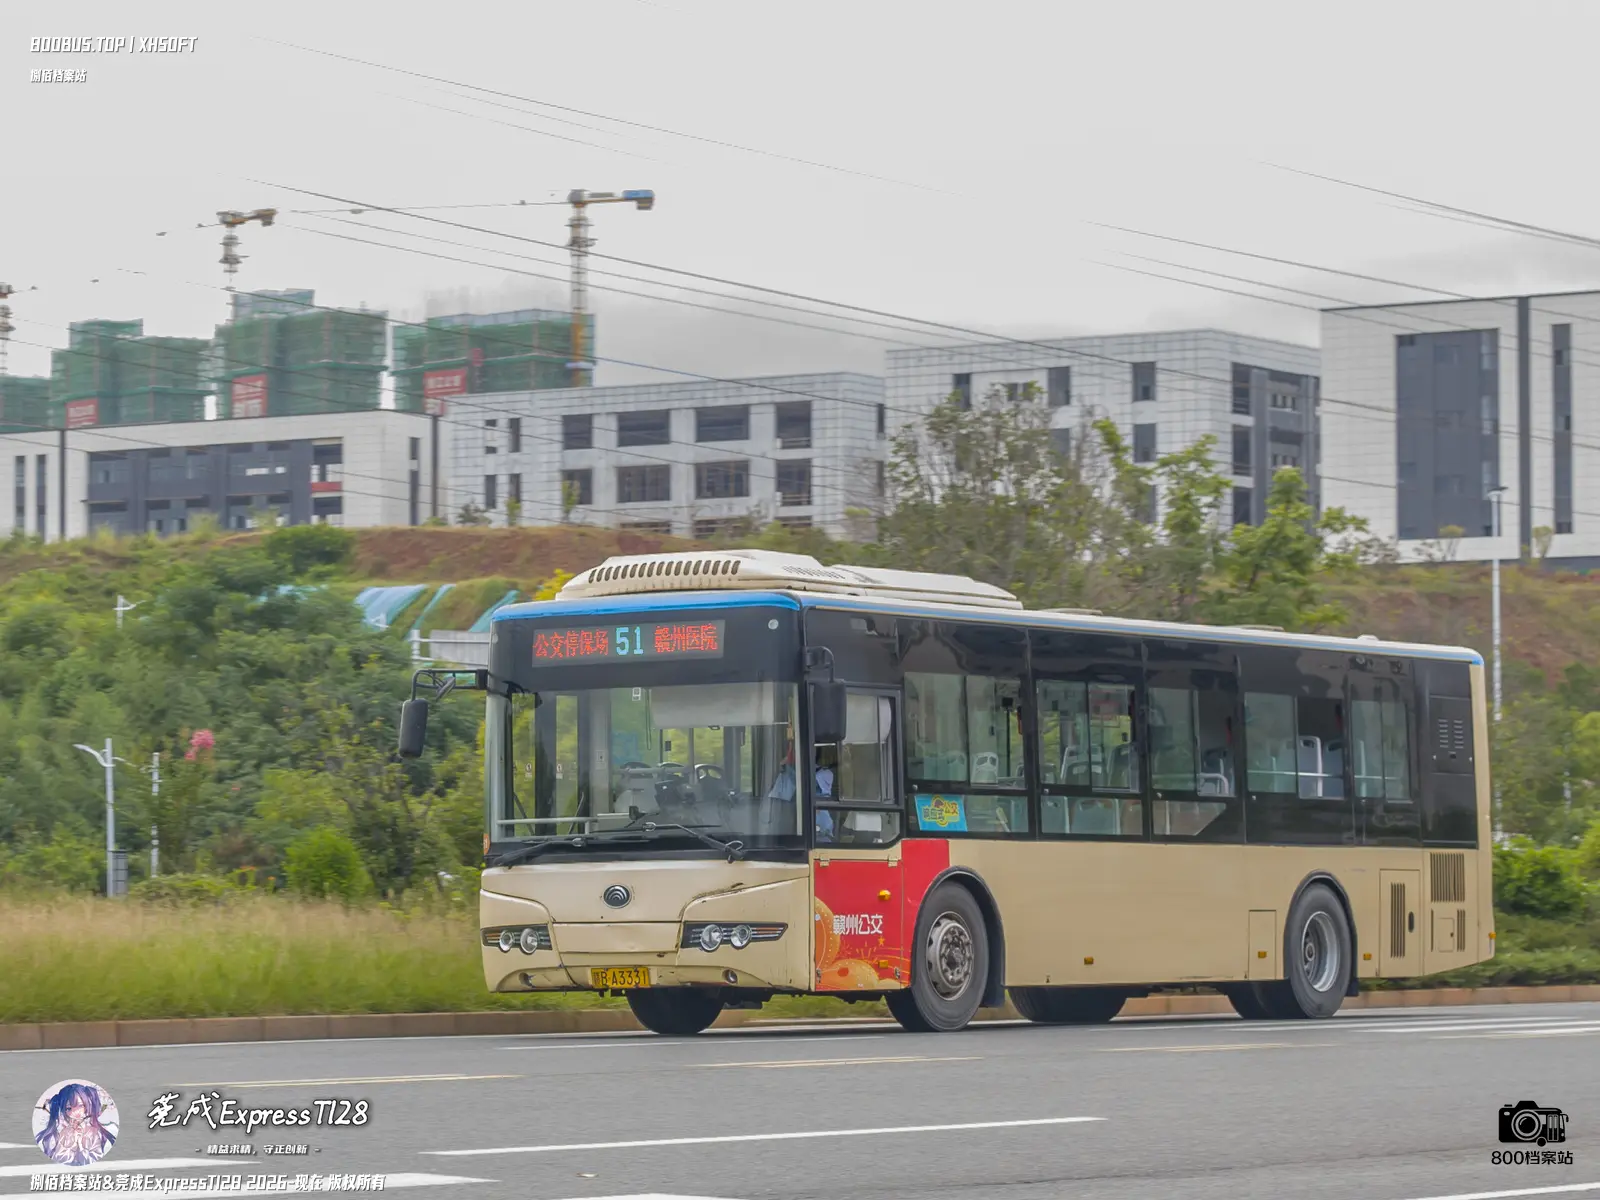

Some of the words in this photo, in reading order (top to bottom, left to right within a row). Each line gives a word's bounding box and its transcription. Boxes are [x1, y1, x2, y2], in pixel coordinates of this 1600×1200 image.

[615, 626, 644, 655] 51
[833, 914, 883, 935] 赣州公交
